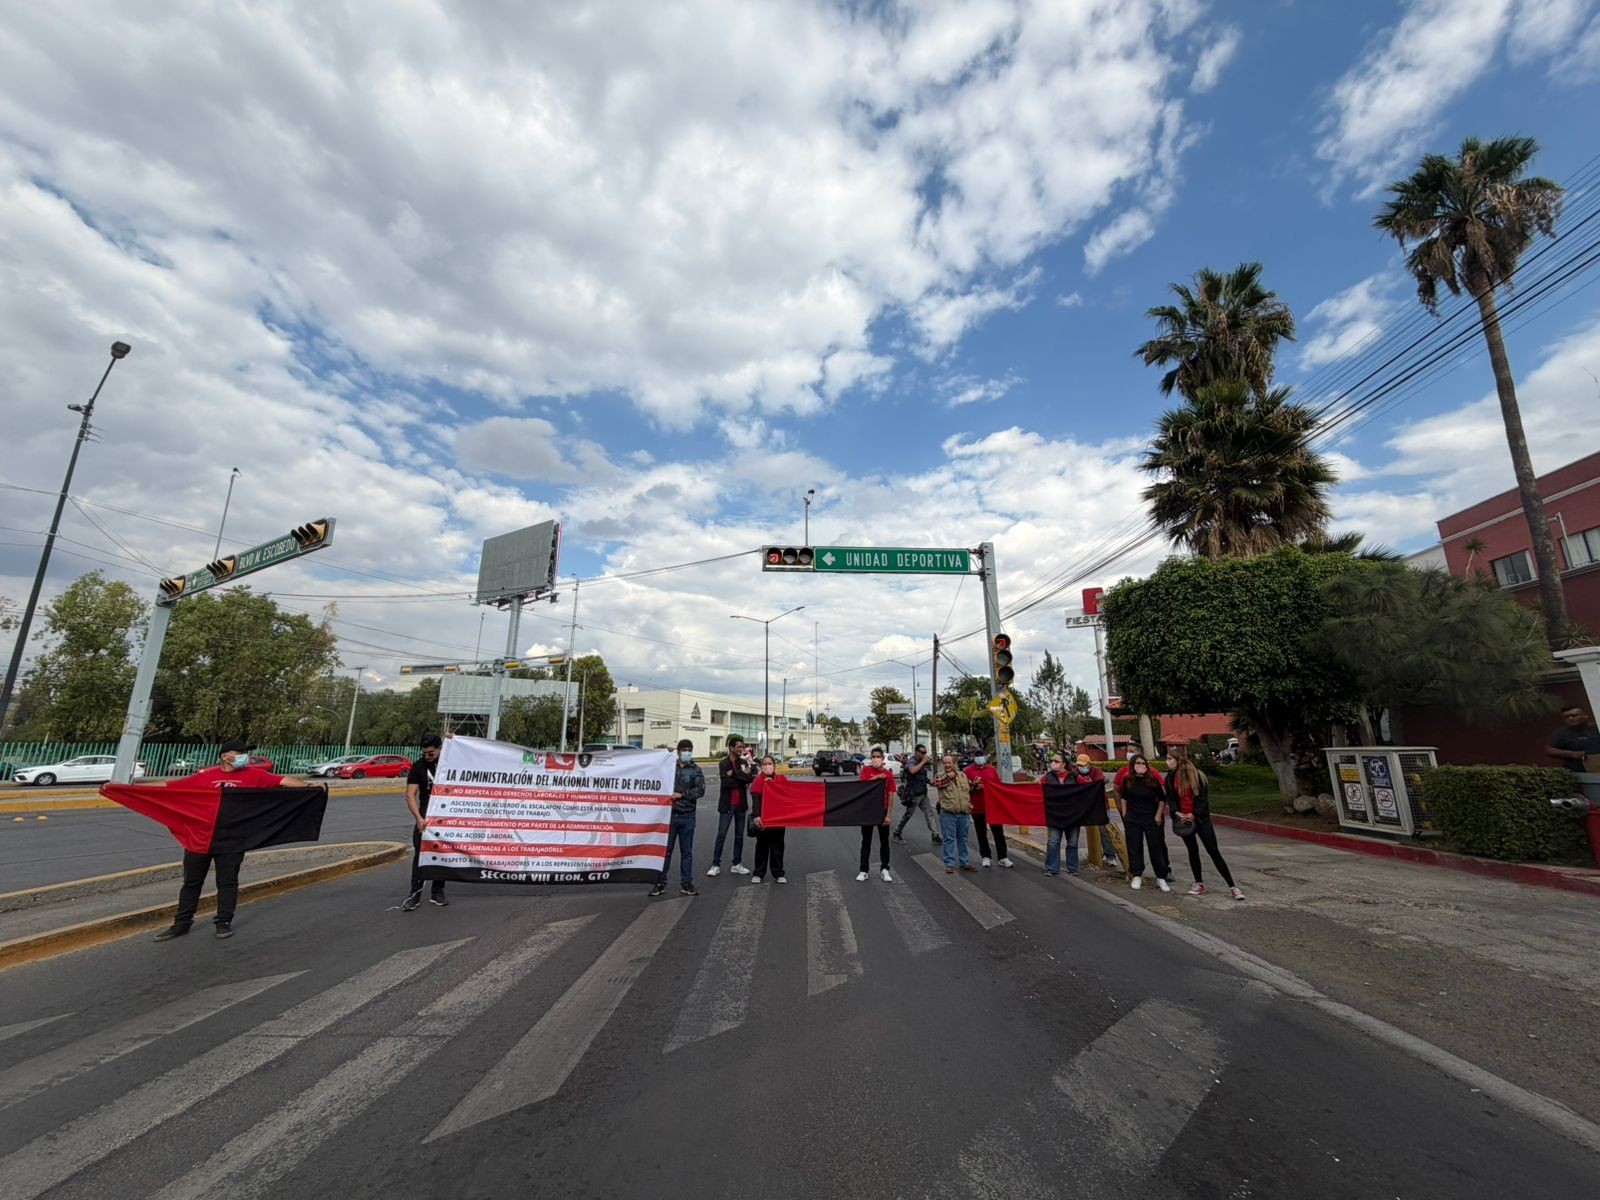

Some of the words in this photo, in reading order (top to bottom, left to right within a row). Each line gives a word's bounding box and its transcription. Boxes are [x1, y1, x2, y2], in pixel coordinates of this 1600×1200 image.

[262, 537, 296, 561] ESCOBEDO
[846, 552, 888, 567] UNIDAD
[897, 553, 962, 568] DEPORTIVA
[446, 769, 457, 781] LA
[459, 769, 533, 785] ADMINISTRACIÓN
[536, 775, 549, 786] DEL
[552, 775, 590, 788] NACIONAL
[593, 777, 619, 790] MONTE
[621, 779, 632, 790] DE
[634, 779, 662, 791] PIEDAD
[480, 870, 526, 881] SECCION
[531, 873, 550, 882] VIII
[554, 873, 584, 882] LEON.
[588, 872, 610, 881] GTO
